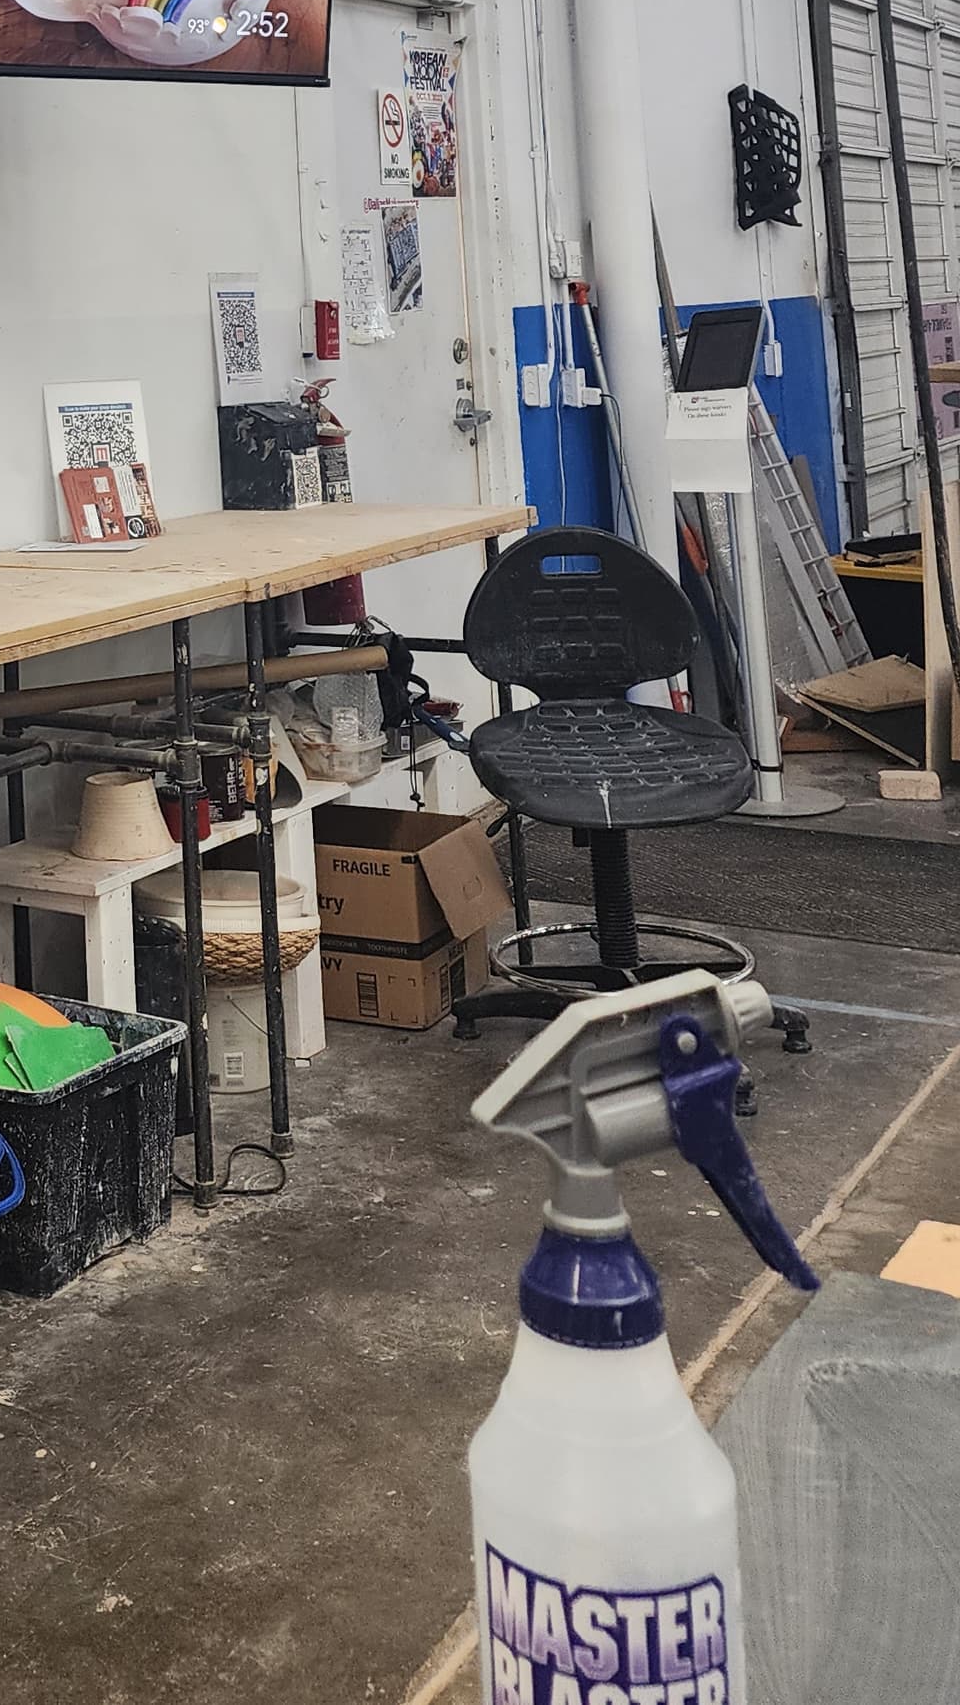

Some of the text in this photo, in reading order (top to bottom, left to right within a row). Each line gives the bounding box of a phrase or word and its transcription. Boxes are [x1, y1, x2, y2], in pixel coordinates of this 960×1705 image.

[187, 17, 210, 34] 93°
[236, 10, 289, 38] 2:52
[409, 49, 448, 67] KOREAN
[410, 75, 447, 92] FESTIVAL
[391, 153, 399, 165] NO
[384, 167, 410, 179] SMOKING
[226, 771, 238, 804] BEHR
[333, 859, 391, 877] FRAGILE
[318, 893, 344, 915] try
[486, 1541, 727, 1683] MASTER
